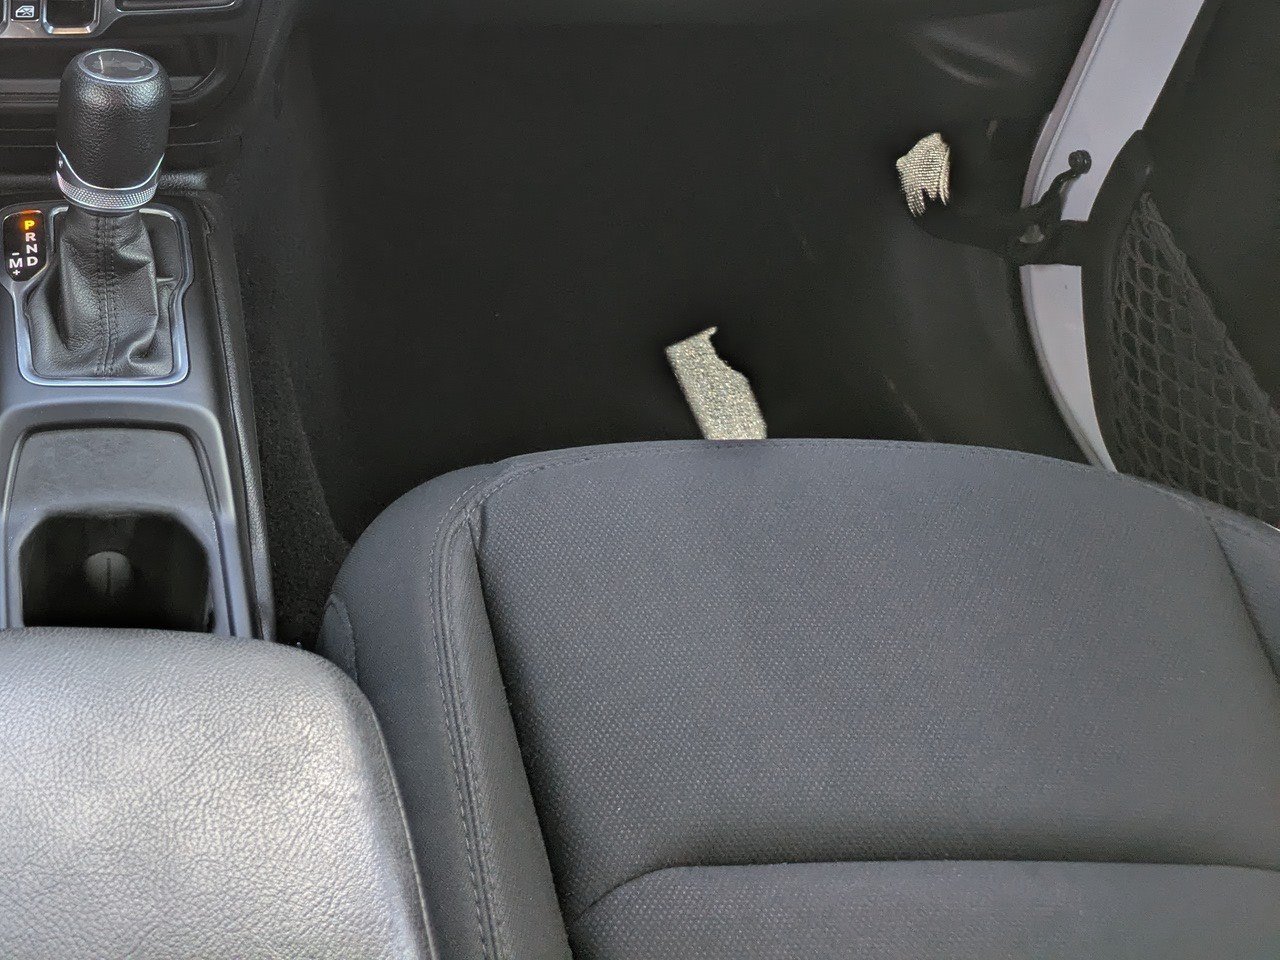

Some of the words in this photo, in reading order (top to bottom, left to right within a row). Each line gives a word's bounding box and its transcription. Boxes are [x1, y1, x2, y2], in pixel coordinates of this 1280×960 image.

[24, 220, 35, 230] P
[25, 232, 36, 242] R
[26, 244, 38, 254] N
[9, 258, 23, 269] M
[27, 256, 39, 267] D
